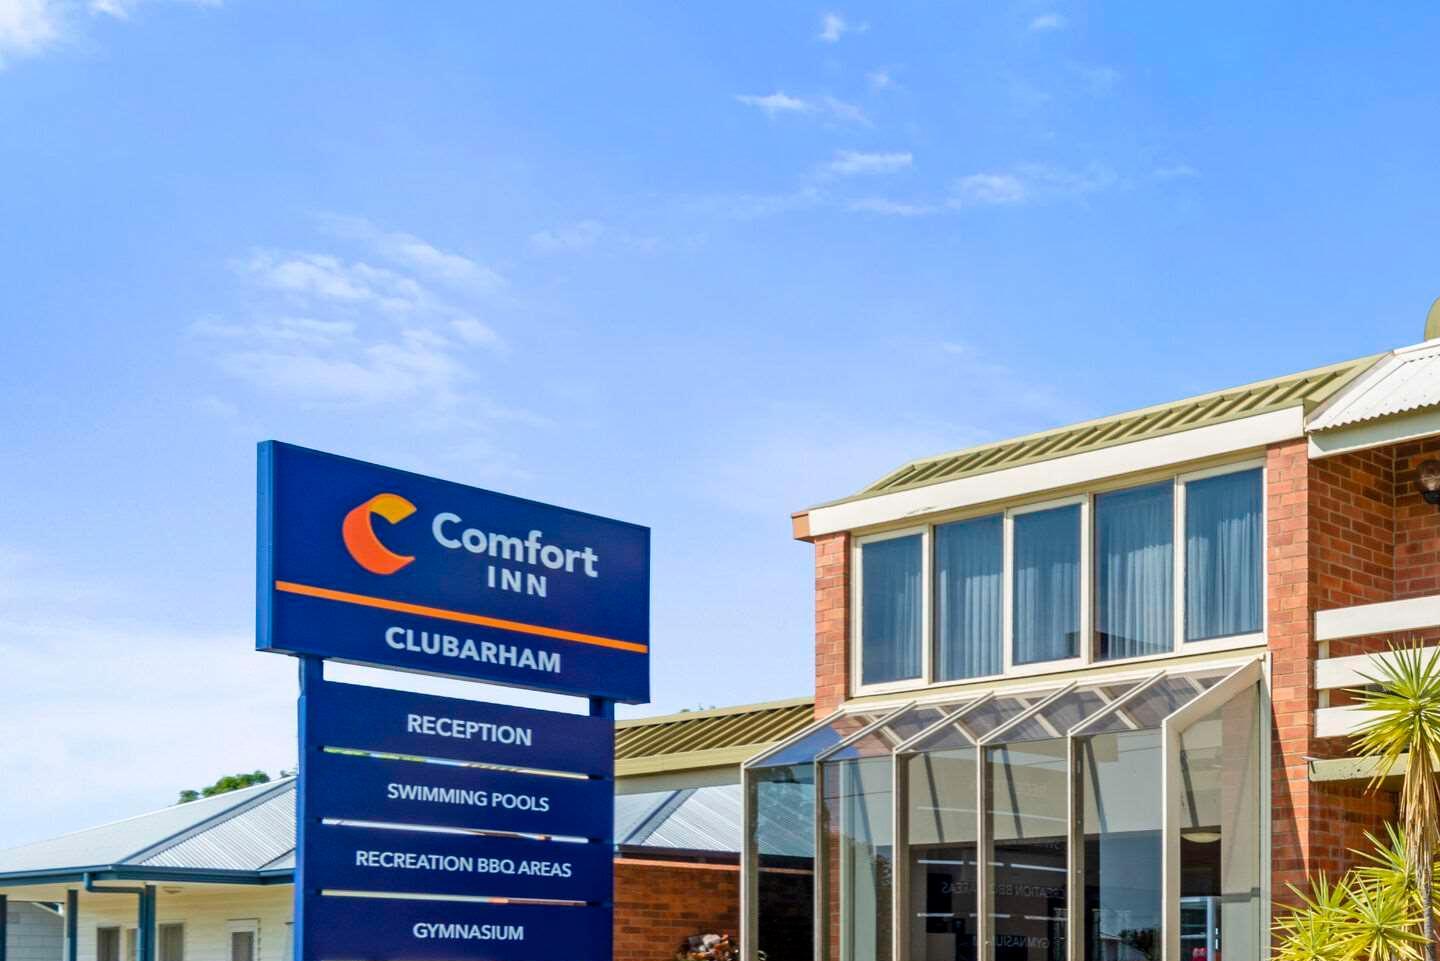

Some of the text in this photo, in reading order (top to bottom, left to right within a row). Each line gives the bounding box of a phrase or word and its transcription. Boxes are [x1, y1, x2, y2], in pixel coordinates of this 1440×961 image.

[432, 513, 599, 578] Comfort
[487, 565, 547, 597] INN
[385, 626, 561, 673] CLUBARHAM
[407, 713, 532, 746] RECEPTION
[387, 783, 549, 812] SWIMMING POOLS
[356, 850, 572, 877] RECREATION BBQ AREAS
[413, 922, 524, 940] GYMNASIUM
